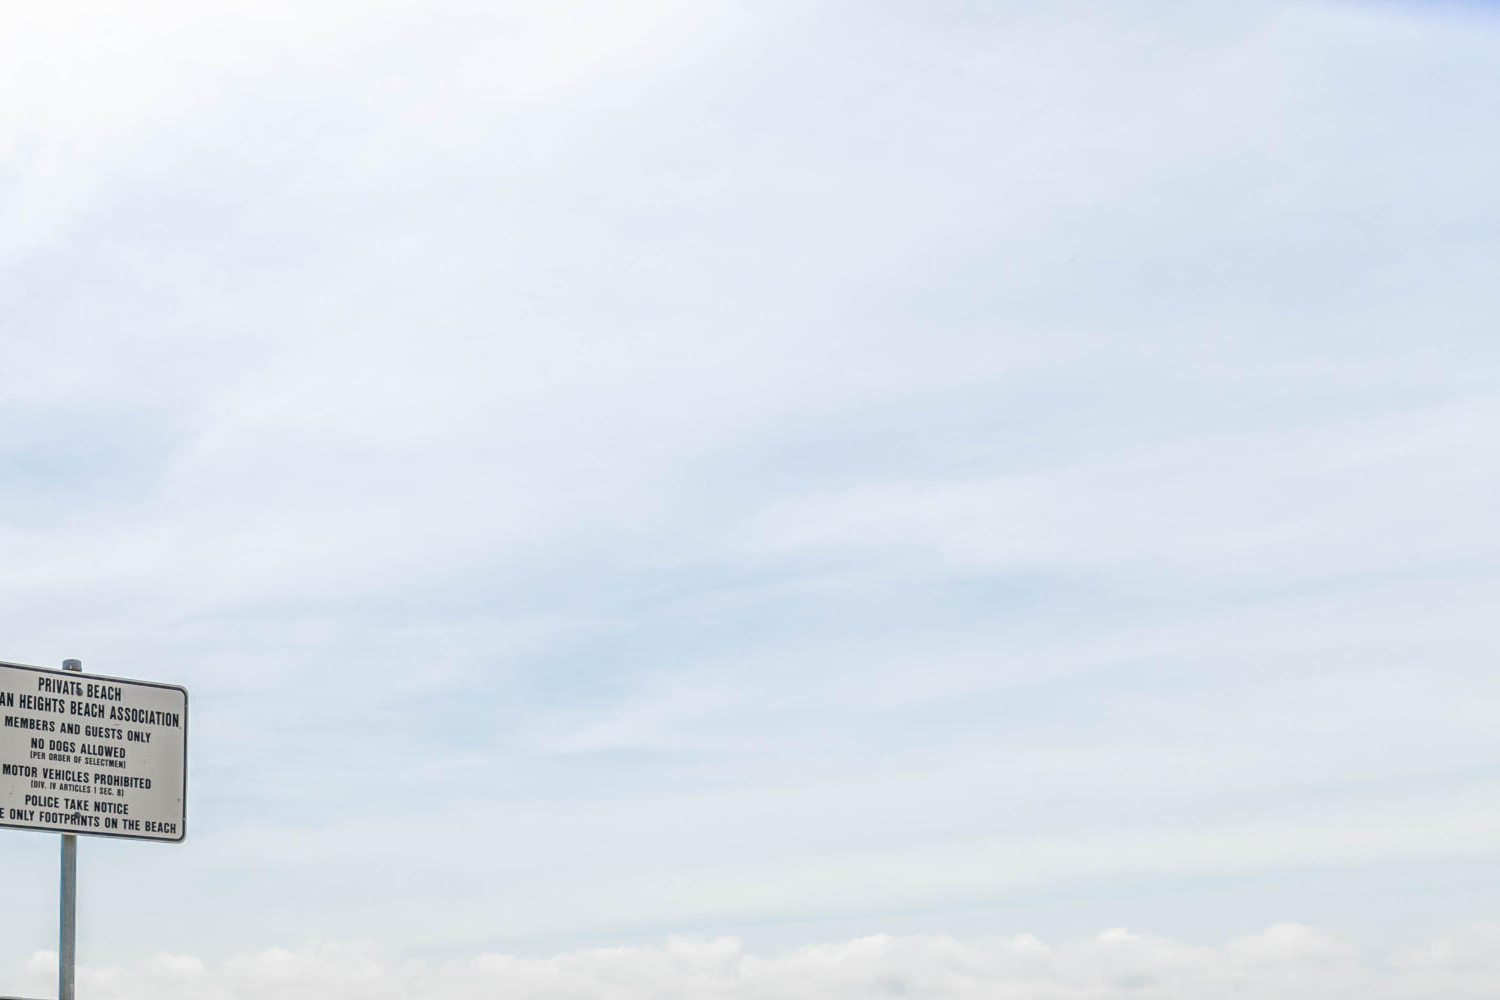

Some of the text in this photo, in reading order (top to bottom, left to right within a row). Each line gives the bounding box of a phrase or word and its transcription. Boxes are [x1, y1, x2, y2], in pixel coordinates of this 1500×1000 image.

[38, 677, 121, 701] PRIVATE BEACH
[19, 694, 65, 713] HEIGHTS
[71, 701, 105, 718] BEACH
[110, 706, 179, 727] ASSOCIATION
[4, 716, 151, 743] MEMBERS AND GUESTS ONLY
[31, 738, 125, 758] NO DOGS ALLOWED
[49, 754, 71, 762] ORDER
[3, 764, 151, 789] MOTOR VEHICLES PROHIBITED
[59, 783, 91, 794] ARTICLES
[99, 787, 115, 796] SEC.
[25, 795, 128, 815] POLICE TAKE NOTICE
[10, 810, 34, 821] ONLY
[39, 813, 100, 827] FOOTPRINTS
[105, 818, 118, 829] ON
[122, 820, 140, 831] THE
[145, 822, 176, 834] BEACH
